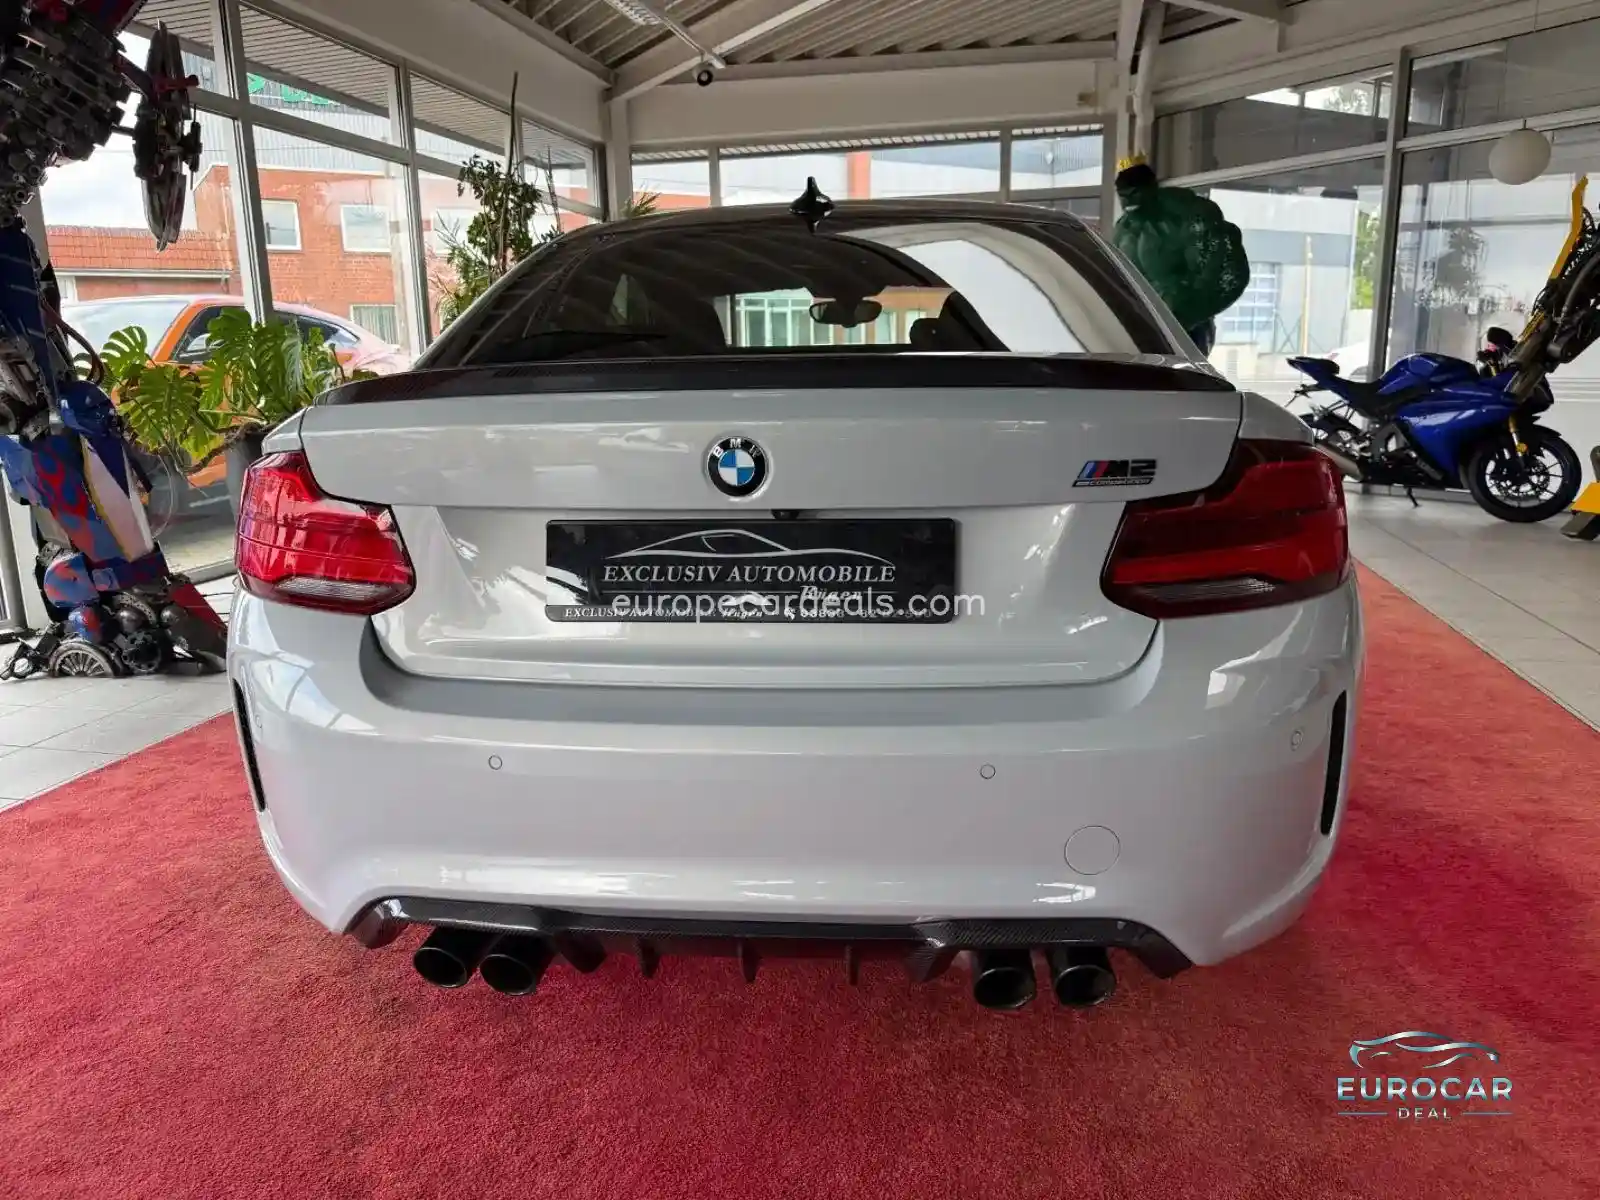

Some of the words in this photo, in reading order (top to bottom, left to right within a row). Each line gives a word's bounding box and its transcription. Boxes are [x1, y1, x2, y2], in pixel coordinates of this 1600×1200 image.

[712, 438, 761, 458] BMW
[603, 565, 724, 582] EXCLUSIV
[728, 565, 896, 582] AUTOMOBILE
